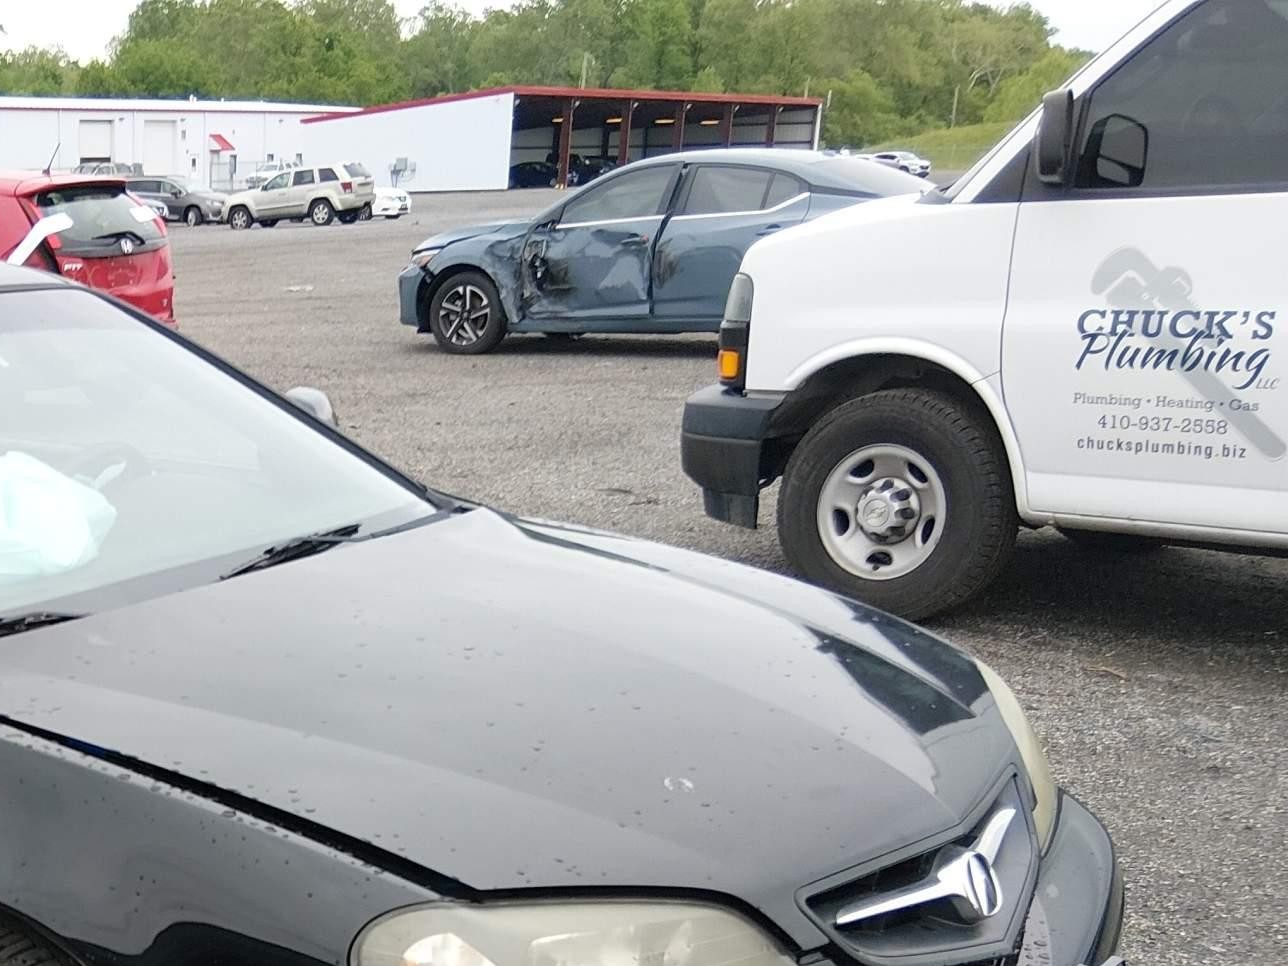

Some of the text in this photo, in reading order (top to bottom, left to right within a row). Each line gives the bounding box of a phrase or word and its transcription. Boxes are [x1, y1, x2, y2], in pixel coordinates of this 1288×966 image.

[1077, 309, 1277, 340] CHUCK'S
[1075, 329, 1270, 390] Plumbing
[1255, 377, 1280, 390] LLC
[1072, 392, 1260, 412] Plumbing Heating Gas
[1097, 414, 1228, 435] 410-937-2558
[1077, 436, 1247, 459] chucksplumbing.biz
